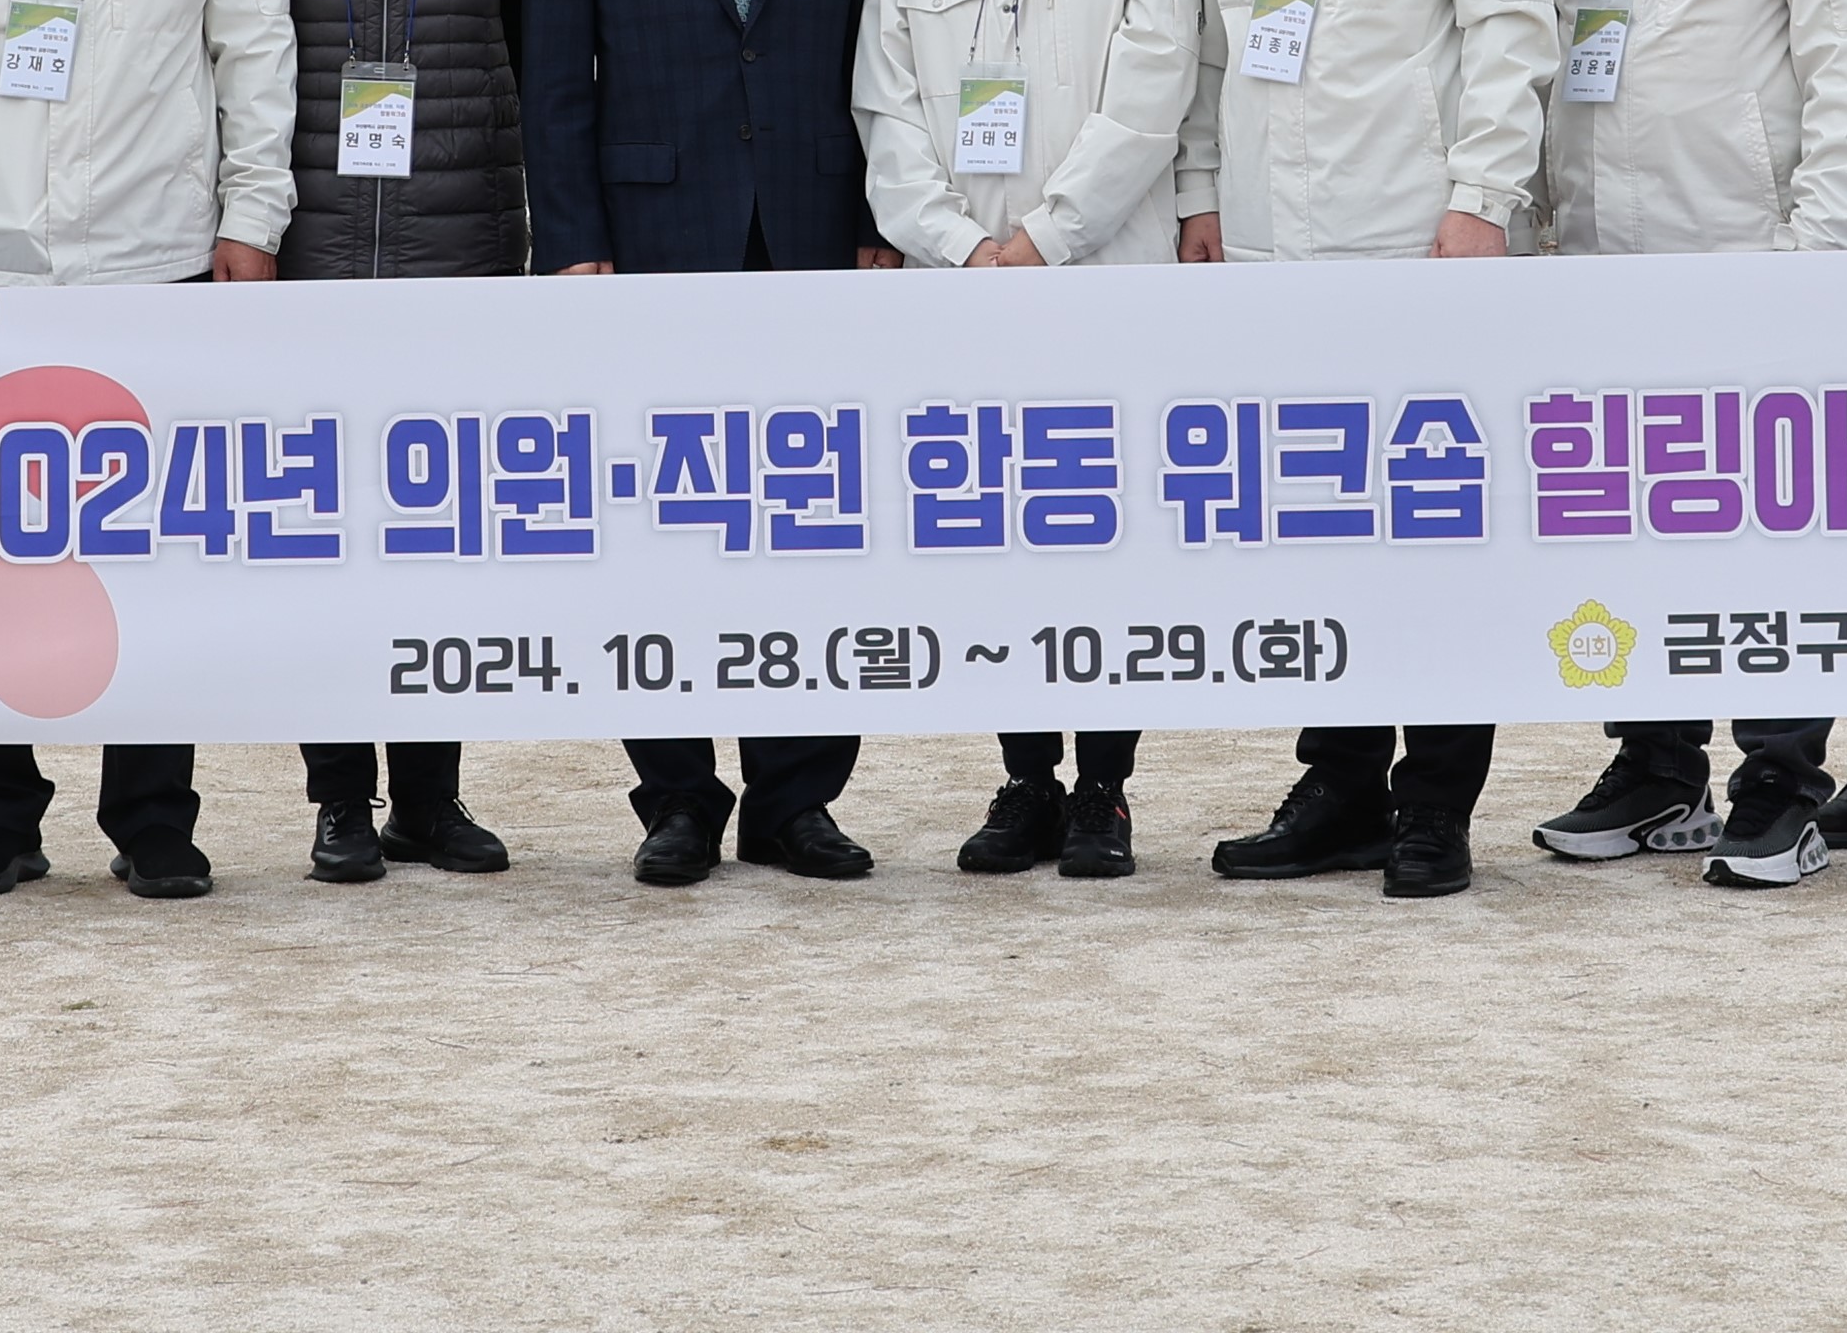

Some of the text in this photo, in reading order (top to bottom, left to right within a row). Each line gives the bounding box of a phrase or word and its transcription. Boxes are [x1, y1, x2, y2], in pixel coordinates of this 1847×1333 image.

[907, 405, 1117, 549] 합동
[1163, 399, 1485, 543] 워크숍
[390, 618, 1348, 694] 2024. 10. 28.(월) ~ 10.29.(화)
[1571, 634, 1612, 658] 의회
